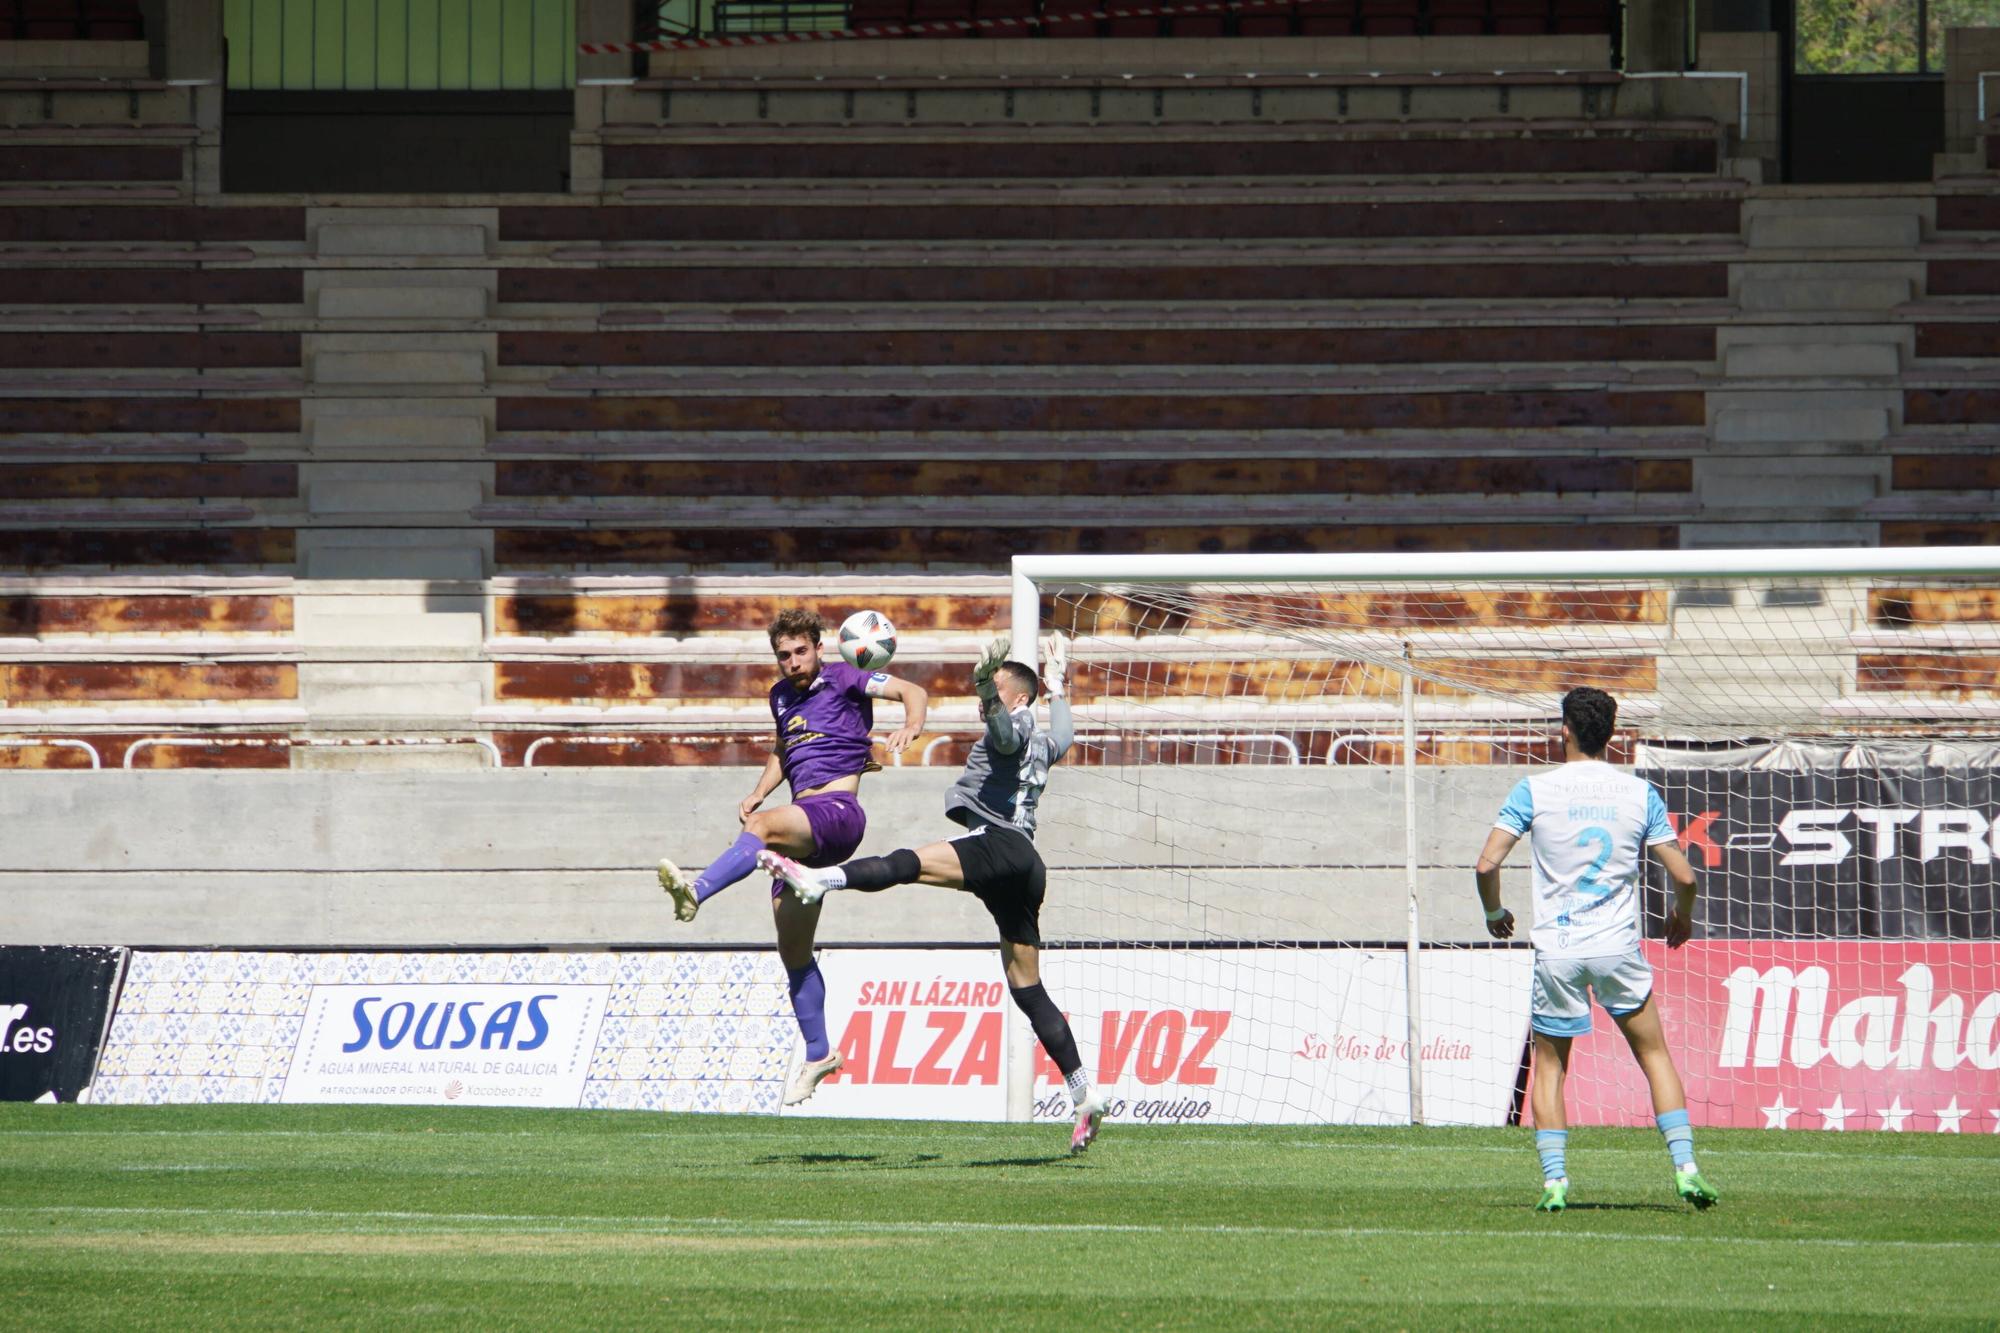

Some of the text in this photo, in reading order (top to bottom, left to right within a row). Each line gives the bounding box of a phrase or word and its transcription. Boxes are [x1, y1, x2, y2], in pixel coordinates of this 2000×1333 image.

[1568, 804, 1617, 822] ROQUE
[1576, 826, 1613, 895] 2
[858, 975, 1003, 1007] SAN LÁZARO
[342, 994, 559, 1053] SOUSAS
[823, 1010, 1003, 1086] ALZA
[1097, 1009, 1232, 1086] VOZ
[1374, 1034, 1396, 1060] de
[318, 1062, 559, 1076] AGUA MINERAL NATURAL DE GALICIA
[319, 1086, 397, 1096] PATROCINADOR
[399, 1086, 439, 1096] OFICIAL
[1033, 1092, 1067, 1118] olo
[1133, 1096, 1213, 1123] equipo
